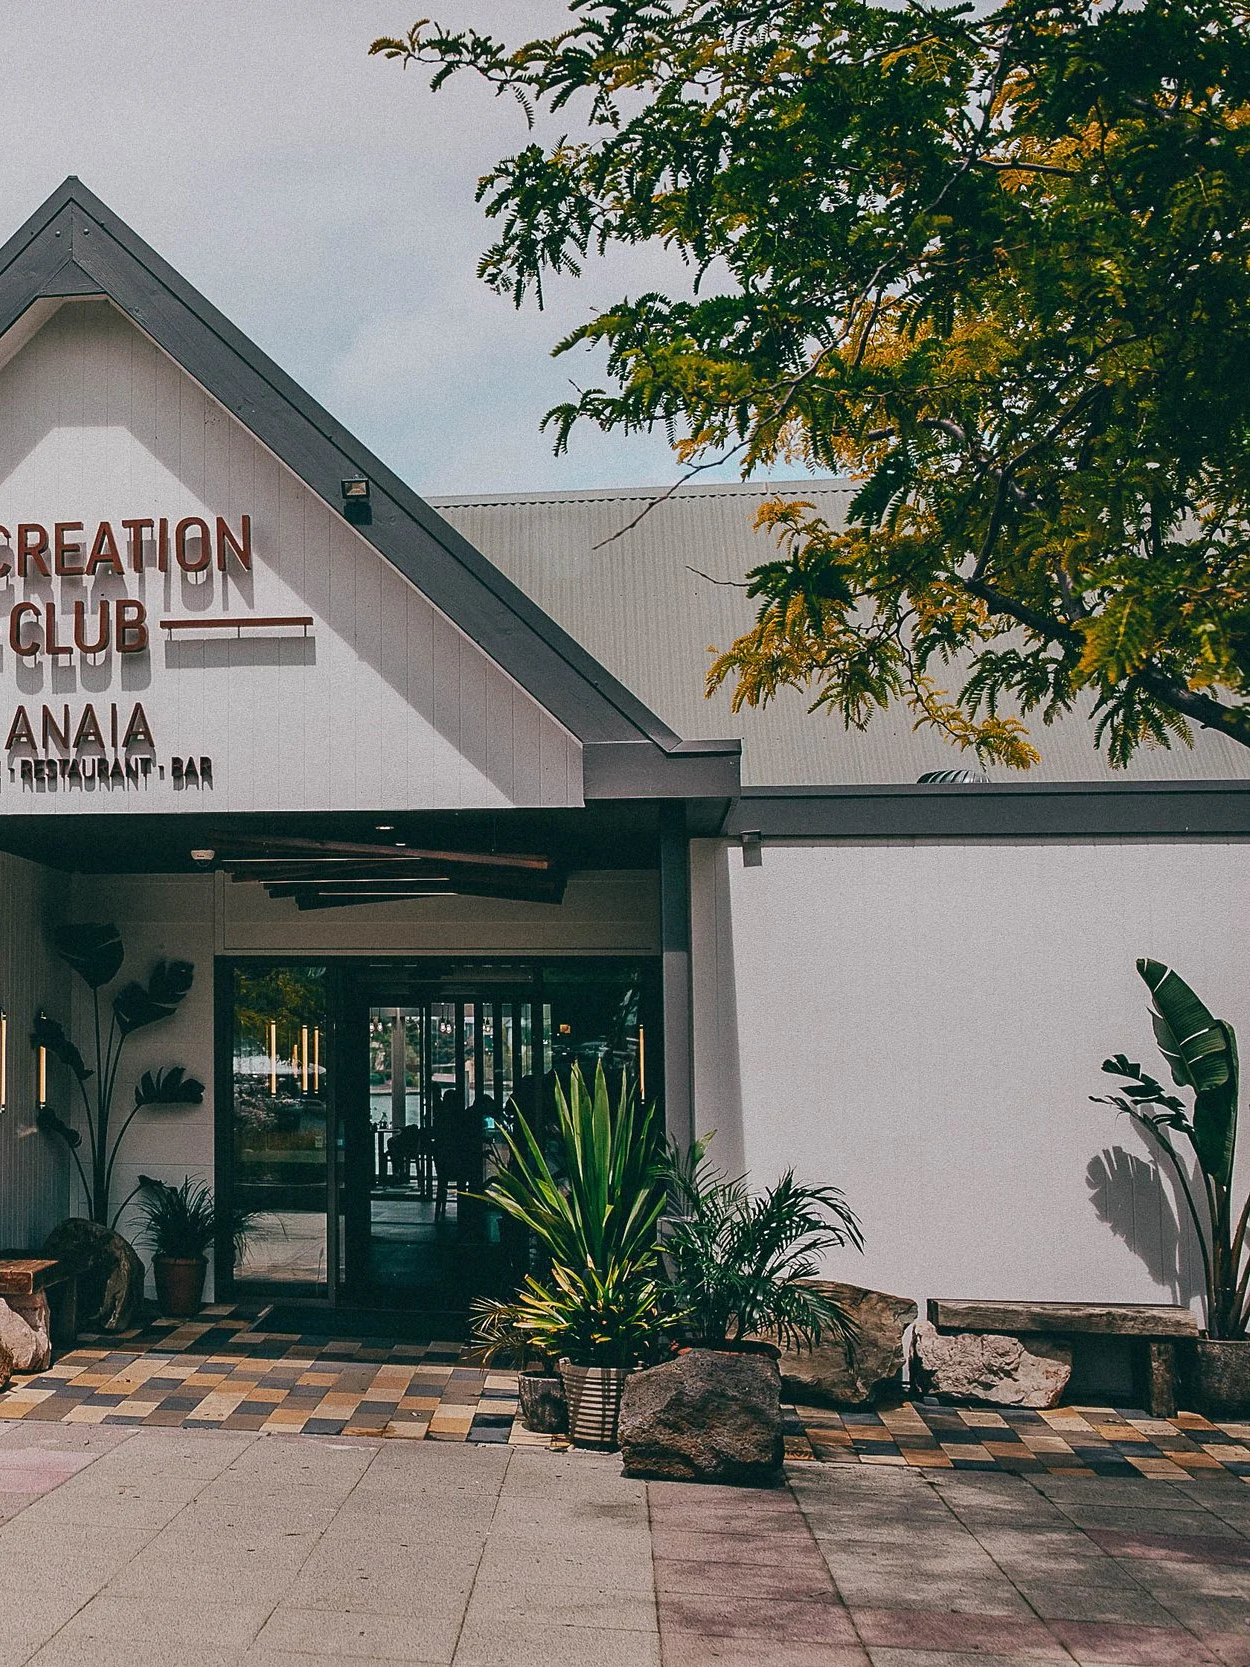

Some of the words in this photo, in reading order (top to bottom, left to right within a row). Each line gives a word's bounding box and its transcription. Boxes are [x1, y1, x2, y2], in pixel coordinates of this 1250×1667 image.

[9, 598, 148, 656] CLUB
[4, 702, 156, 751] ANAIA
[20, 757, 152, 781] RESTAURANT
[171, 756, 213, 778] BAR
